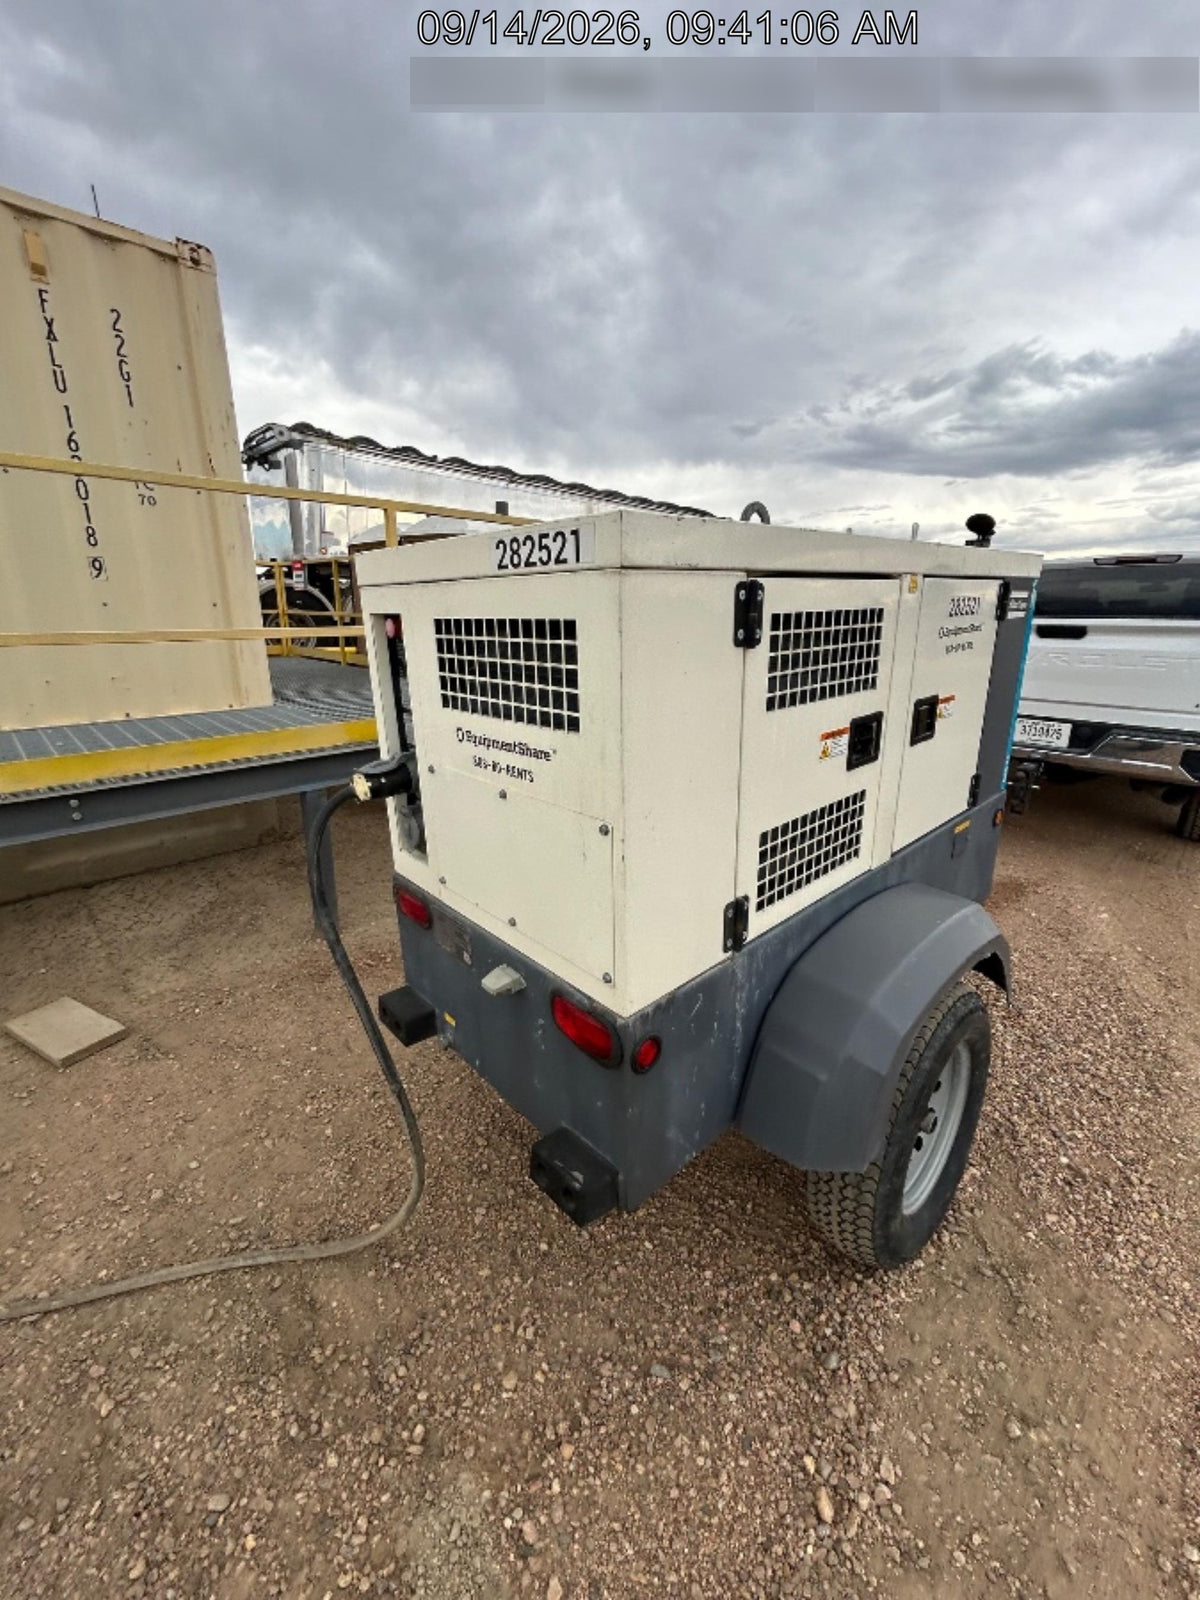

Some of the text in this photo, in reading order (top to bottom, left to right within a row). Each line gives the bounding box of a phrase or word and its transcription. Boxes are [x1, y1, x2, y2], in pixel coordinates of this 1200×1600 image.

[38, 288, 67, 393] FXLU
[109, 308, 133, 407] 22G1
[495, 528, 581, 570] 282521
[465, 730, 552, 761] EquipmentShare
